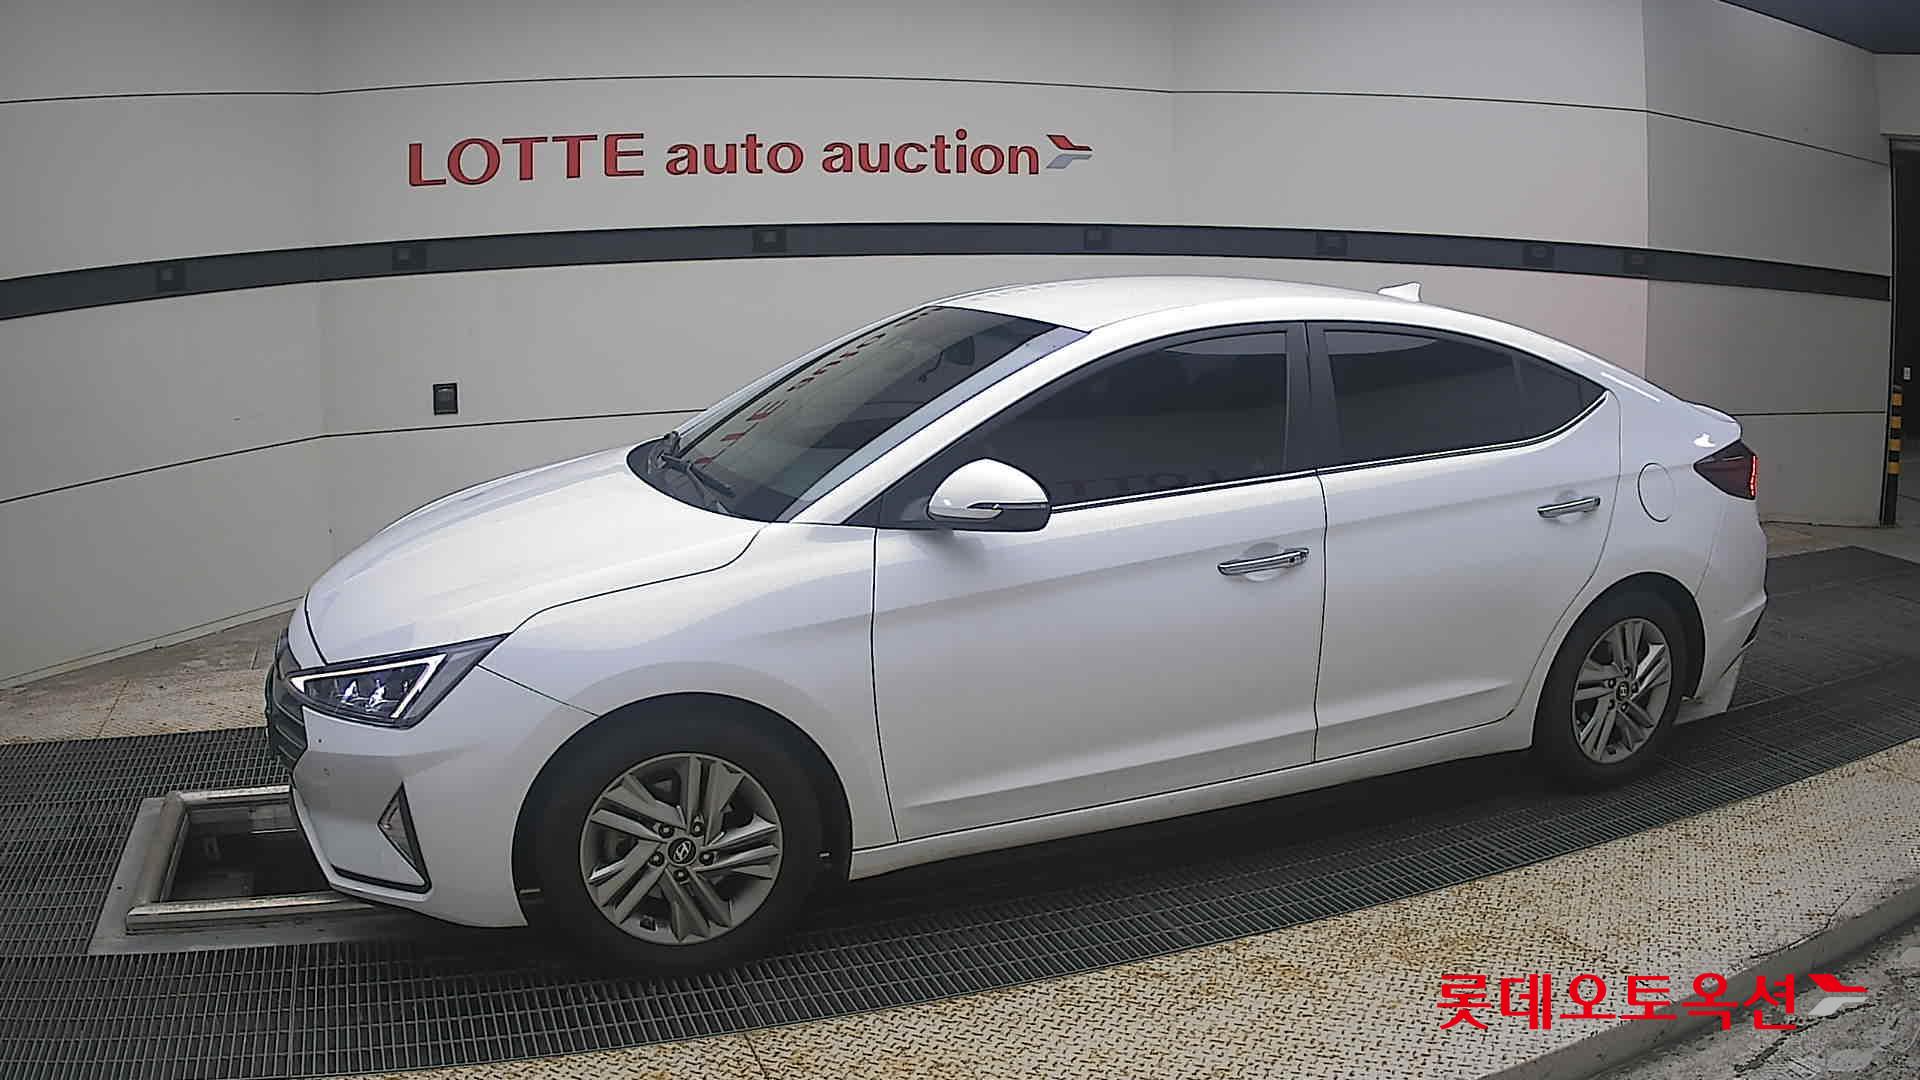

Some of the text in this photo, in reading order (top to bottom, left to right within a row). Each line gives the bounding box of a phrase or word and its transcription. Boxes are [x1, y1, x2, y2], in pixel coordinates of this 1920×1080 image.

[409, 128, 1040, 187] LOTTE auto auction
